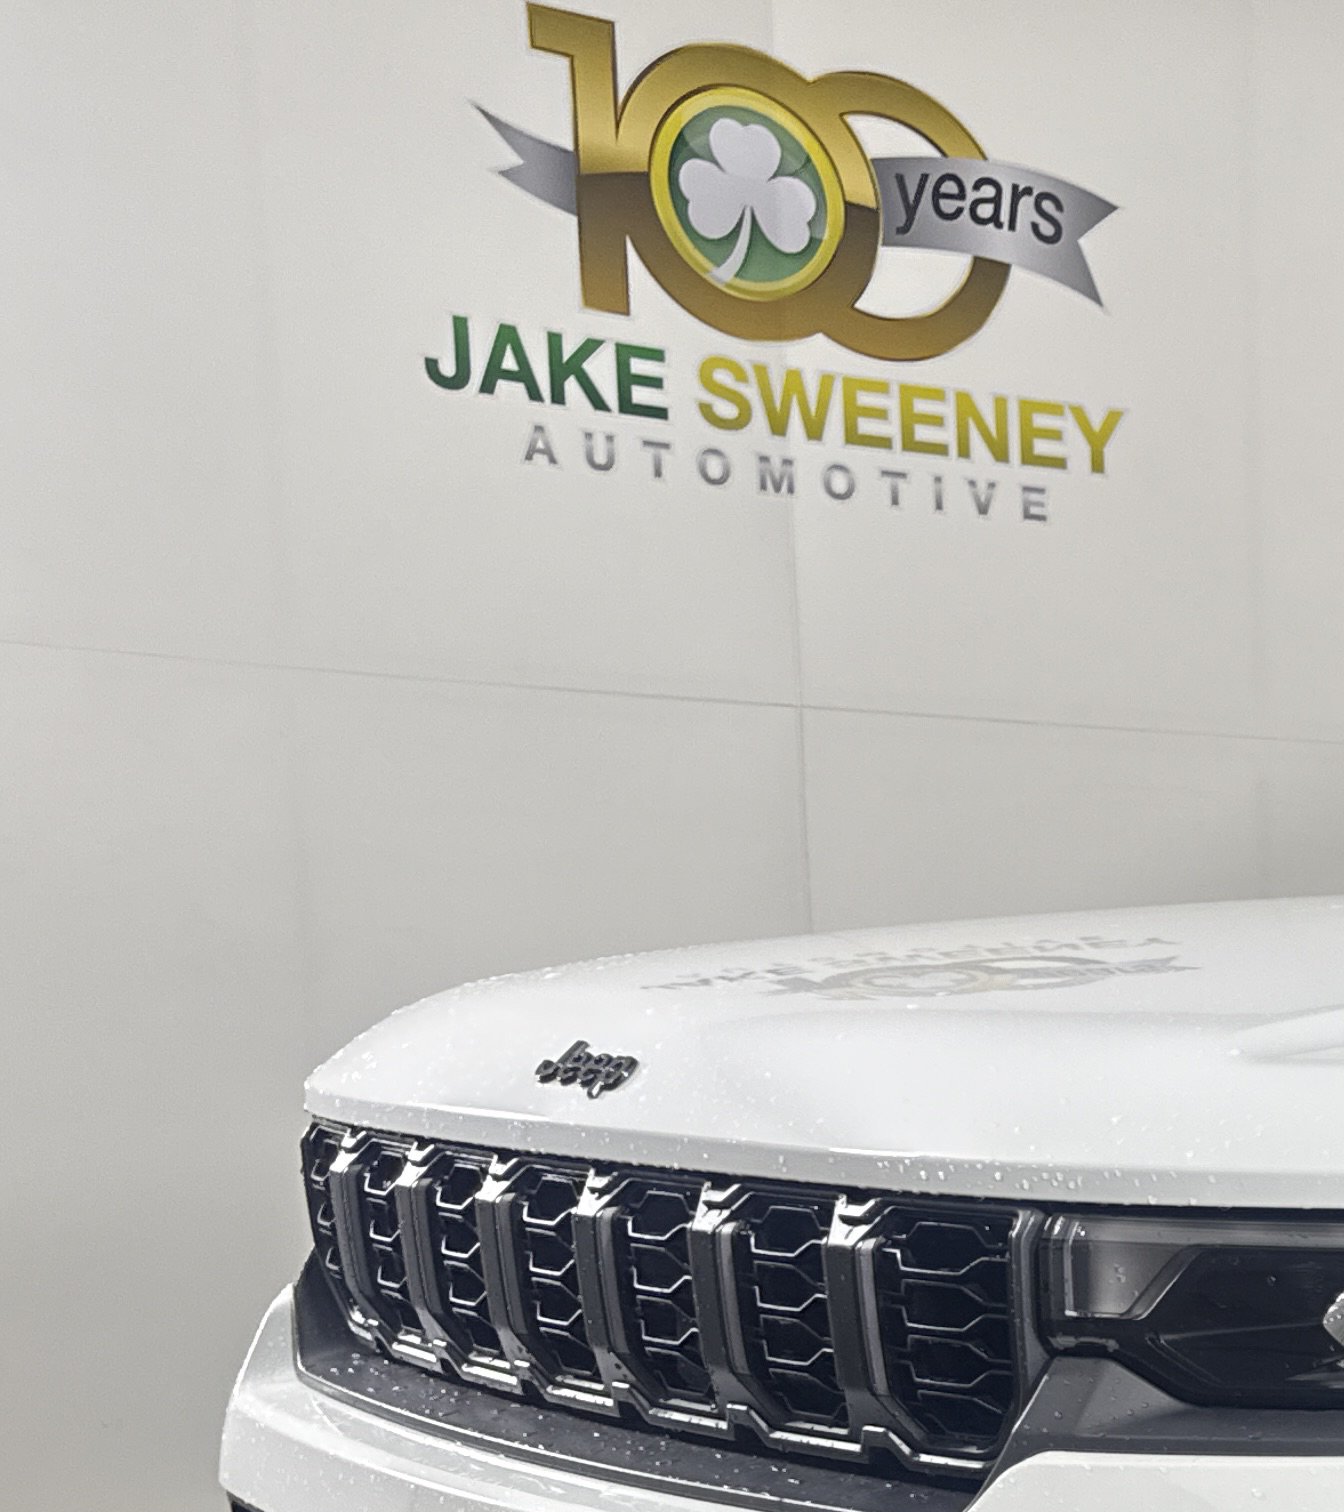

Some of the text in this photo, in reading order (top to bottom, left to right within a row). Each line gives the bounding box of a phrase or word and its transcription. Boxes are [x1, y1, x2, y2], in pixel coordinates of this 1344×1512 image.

[525, 2, 1011, 362] 100
[894, 170, 1066, 245] years
[424, 315, 1124, 474] JAKE SWEENEY
[524, 424, 1049, 522] AUTOMOTIVE
[535, 1040, 640, 1099] Jeep
